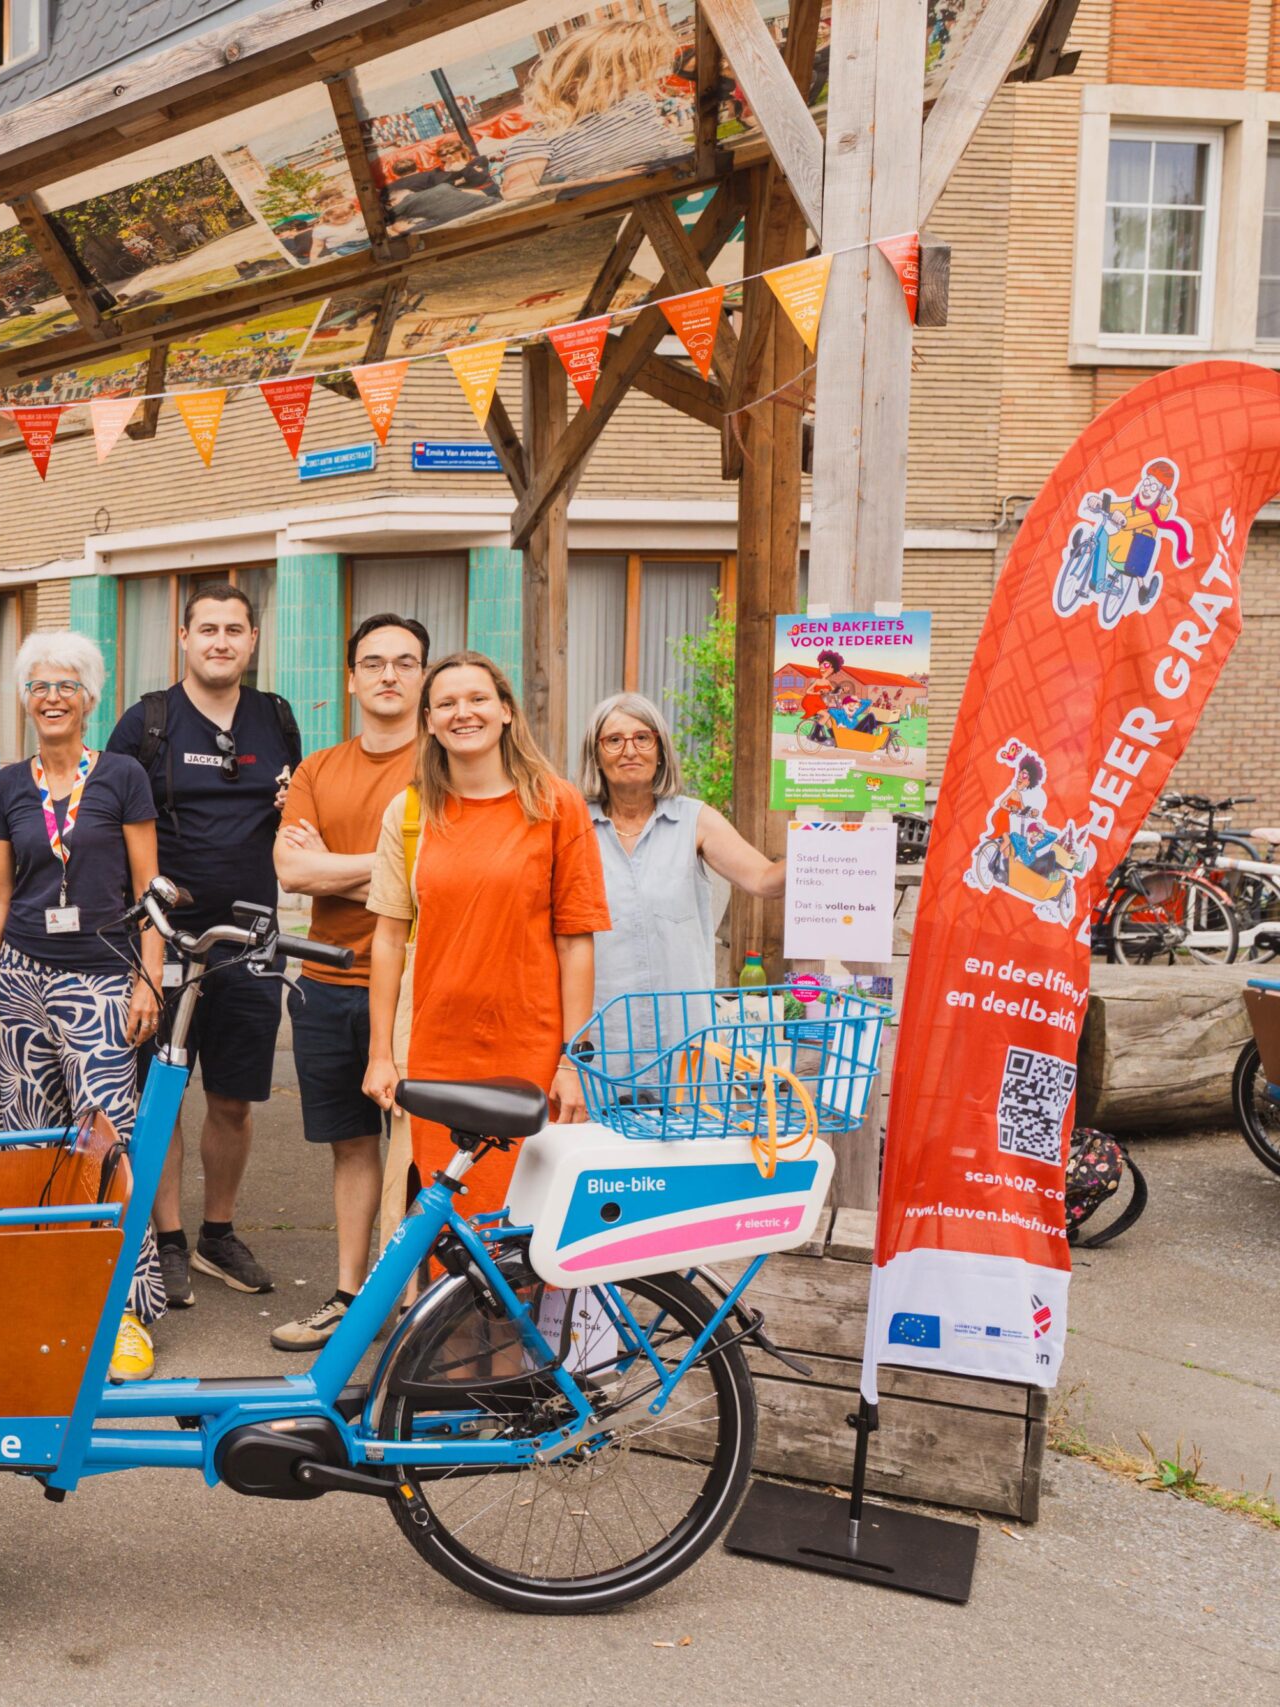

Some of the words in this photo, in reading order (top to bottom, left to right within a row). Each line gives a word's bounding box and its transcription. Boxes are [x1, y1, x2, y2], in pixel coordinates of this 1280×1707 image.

[832, 620, 905, 632] BAKFIETS
[791, 636, 834, 647] VOOR
[838, 634, 913, 647] IEDEREEN
[796, 853, 819, 863] Stad
[822, 854, 858, 864] Leuven
[796, 866, 839, 875] trakteert
[842, 868, 855, 876] op
[858, 868, 877, 876] een
[794, 900, 812, 909] Dat
[815, 901, 822, 909] is
[825, 902, 856, 911] vollen
[858, 903, 876, 912] bak
[794, 915, 837, 925] genieten
[587, 1175, 666, 1194] Blue-bike
[965, 1171, 1003, 1185] scan
[1014, 1176, 1065, 1201] QR-co
[745, 1217, 781, 1229] electric
